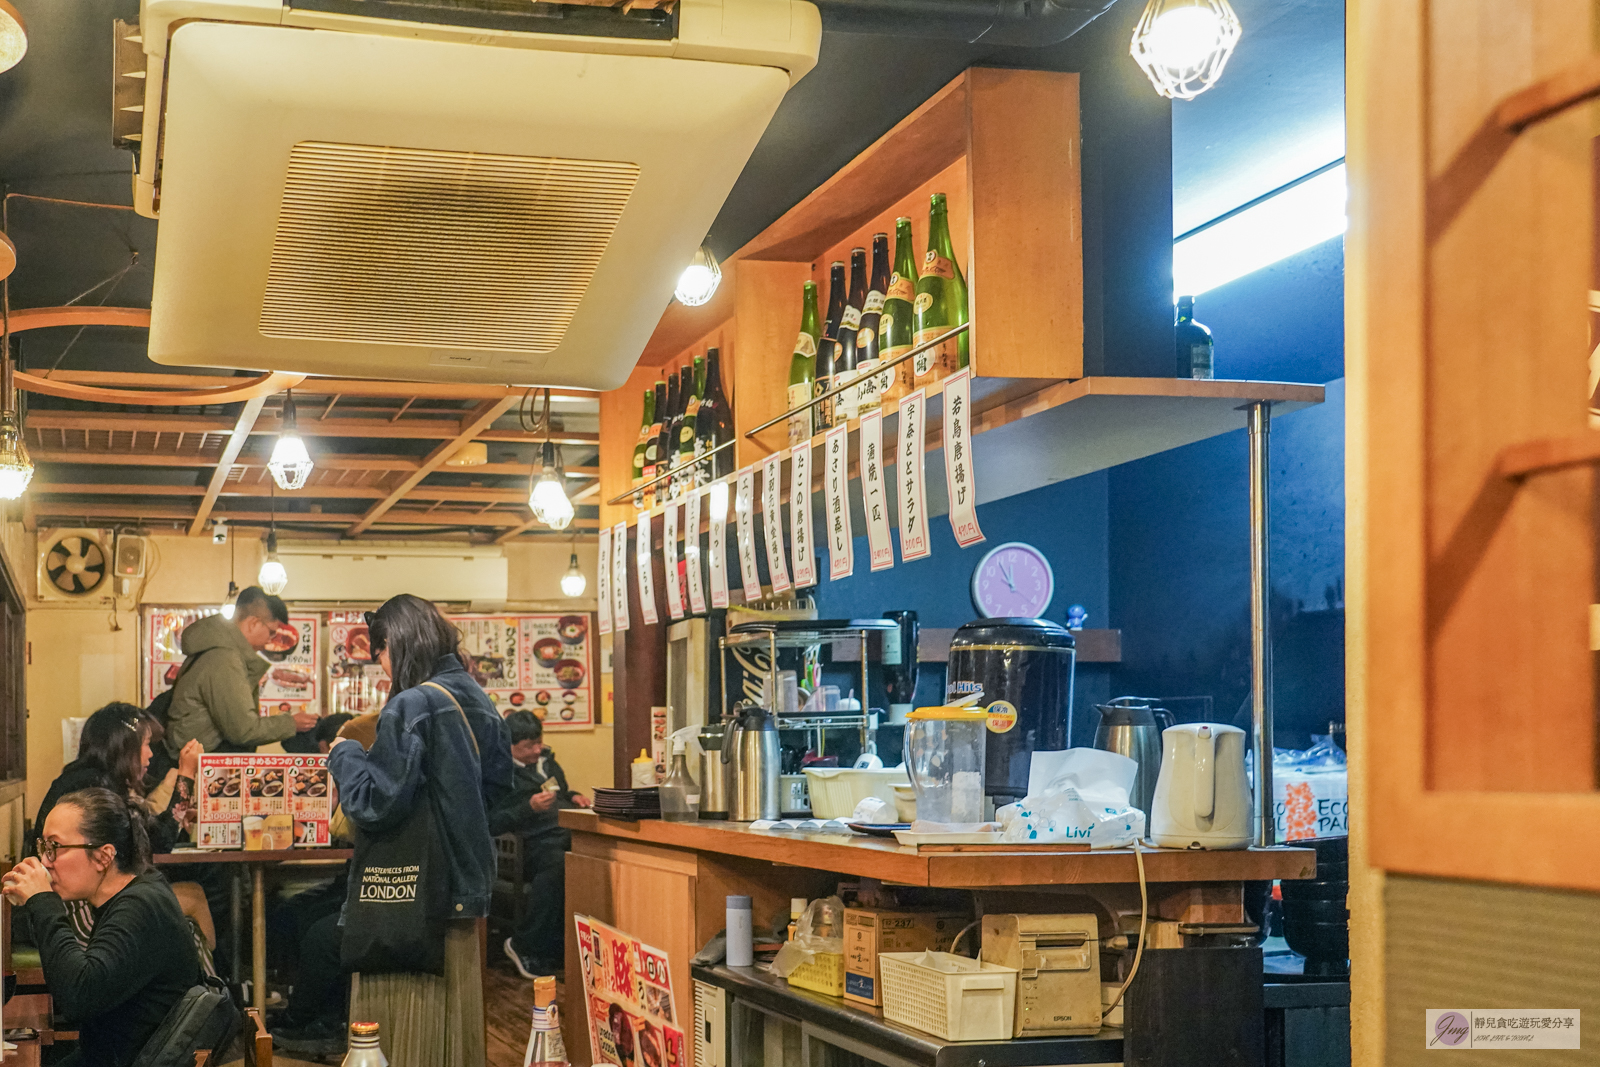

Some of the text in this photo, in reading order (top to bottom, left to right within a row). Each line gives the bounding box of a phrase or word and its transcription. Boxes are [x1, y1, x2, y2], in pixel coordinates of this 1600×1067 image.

[952, 395, 967, 505] 若鳥唐揚げ
[866, 442, 882, 522] 蒲焼一匹
[957, 681, 983, 693] Hits
[1066, 823, 1095, 838] Livi
[364, 865, 420, 875] MASTERPIECES FROM
[362, 875, 419, 884] NATIONAL GALLERY
[360, 884, 417, 899] LONDON
